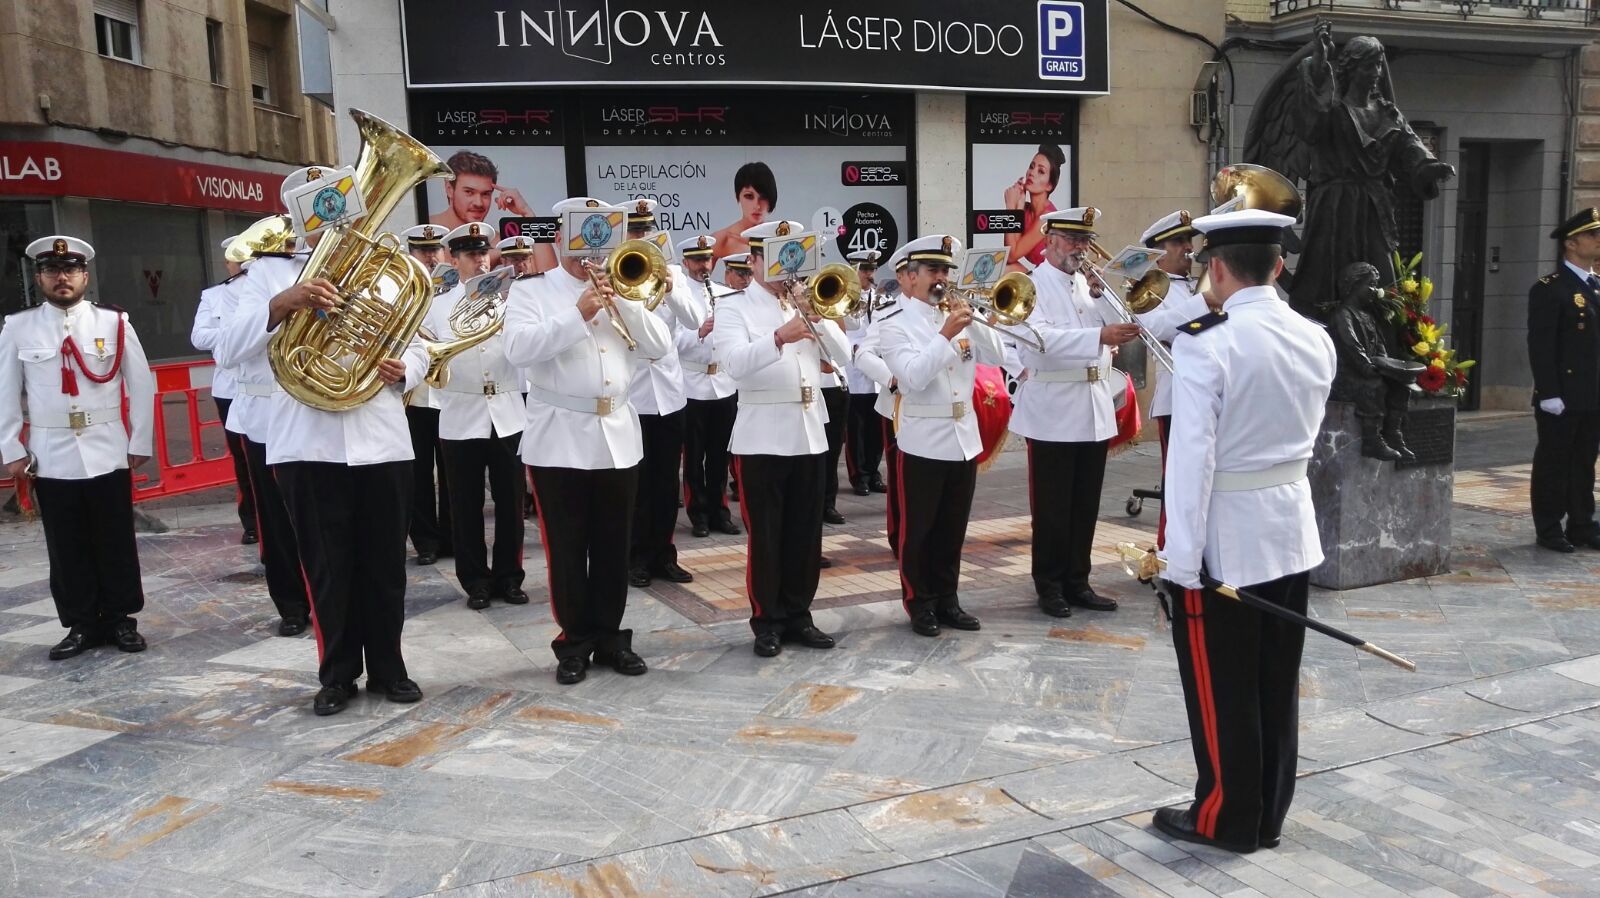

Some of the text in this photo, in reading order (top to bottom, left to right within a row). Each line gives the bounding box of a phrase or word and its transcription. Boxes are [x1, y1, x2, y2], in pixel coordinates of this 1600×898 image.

[494, 10, 724, 47] INNOVA
[800, 9, 1024, 57] LÁSER DIODO
[1048, 10, 1073, 51] P
[651, 52, 726, 66] centros
[1046, 61, 1079, 73] GRATIS
[805, 113, 892, 130] INNOVA
[0, 156, 62, 181] LAB
[598, 161, 706, 179] LA DEPILACIÓN
[614, 182, 657, 191] DE LA QUE
[860, 174, 899, 182] DOLOR
[196, 175, 264, 202] VISIONLAB
